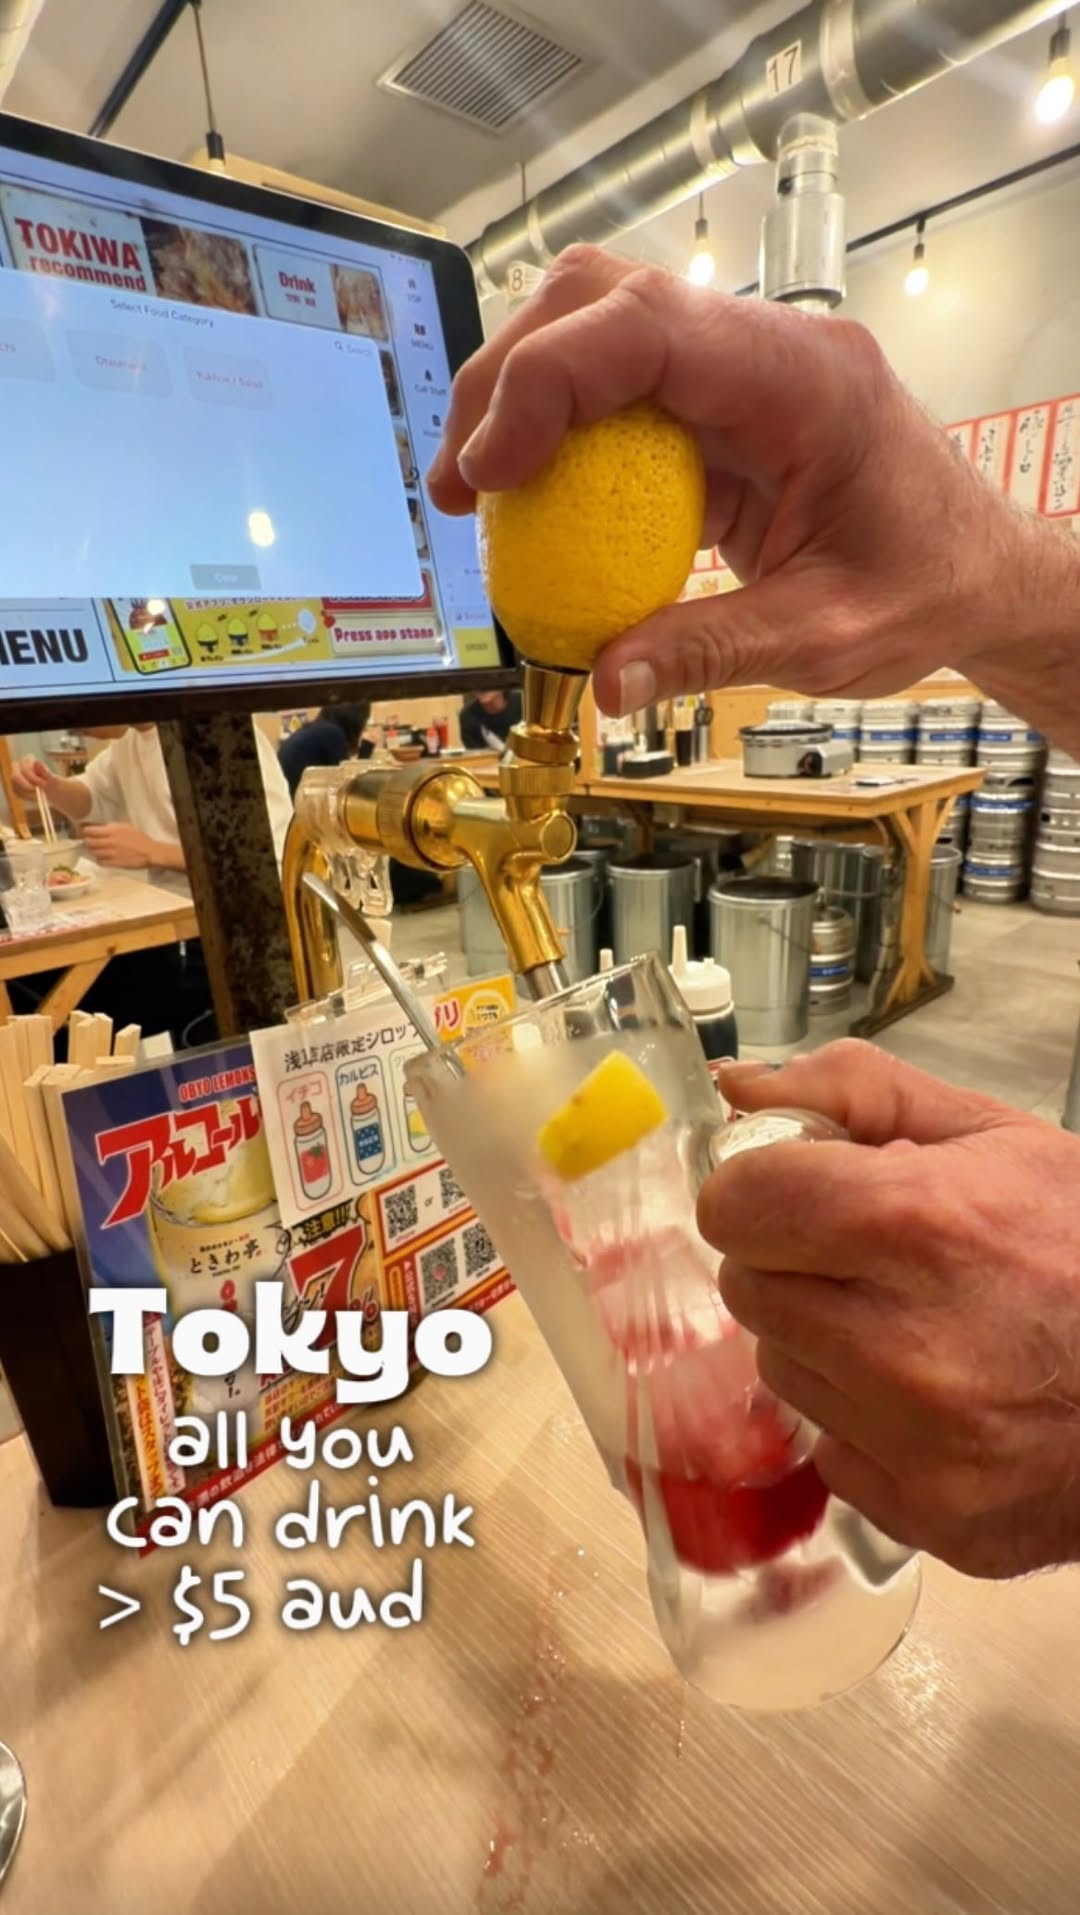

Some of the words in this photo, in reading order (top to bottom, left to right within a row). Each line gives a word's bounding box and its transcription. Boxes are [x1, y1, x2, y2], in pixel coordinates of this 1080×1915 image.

[768, 45, 798, 93] 17
[14, 217, 142, 272] TOKIWA
[29, 255, 147, 292] recommend
[278, 271, 317, 294] Drink
[333, 627, 373, 643] Press
